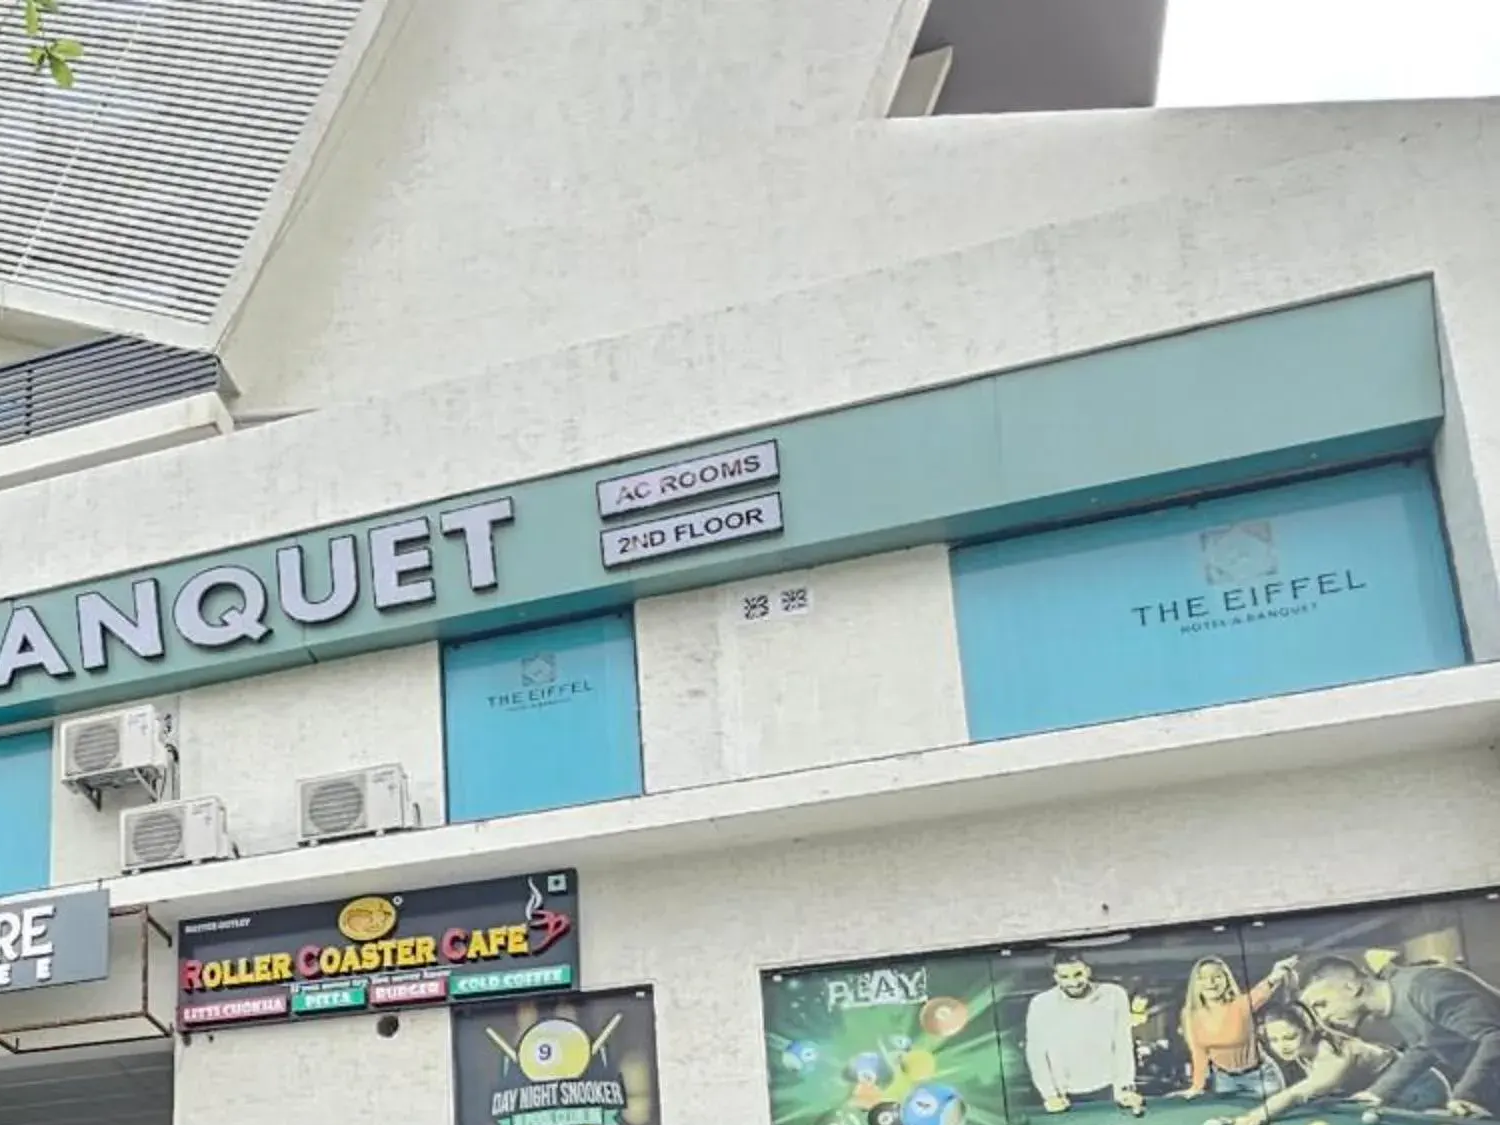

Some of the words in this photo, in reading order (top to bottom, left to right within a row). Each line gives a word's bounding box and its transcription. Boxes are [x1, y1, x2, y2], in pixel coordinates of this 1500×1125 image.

[615, 481, 652, 504] AC
[660, 455, 762, 494] ROOMS
[617, 529, 666, 554] 2ND
[673, 507, 764, 542] FLOOR
[1131, 596, 1209, 627] THE
[1223, 569, 1367, 612] EIFFEL
[487, 691, 525, 708] THE
[528, 680, 594, 701] EIFFEL
[181, 952, 294, 990] ROLLER
[297, 936, 437, 978] COASTER
[442, 923, 530, 961] CAFE
[457, 975, 499, 991] COLD
[503, 968, 563, 986] COFFEE
[375, 981, 440, 1001] BURGER
[828, 966, 928, 1012] PLAY
[491, 1087, 519, 1116] DAY
[519, 1082, 559, 1110] NIGHT
[559, 1080, 624, 1105] SNOOKER
